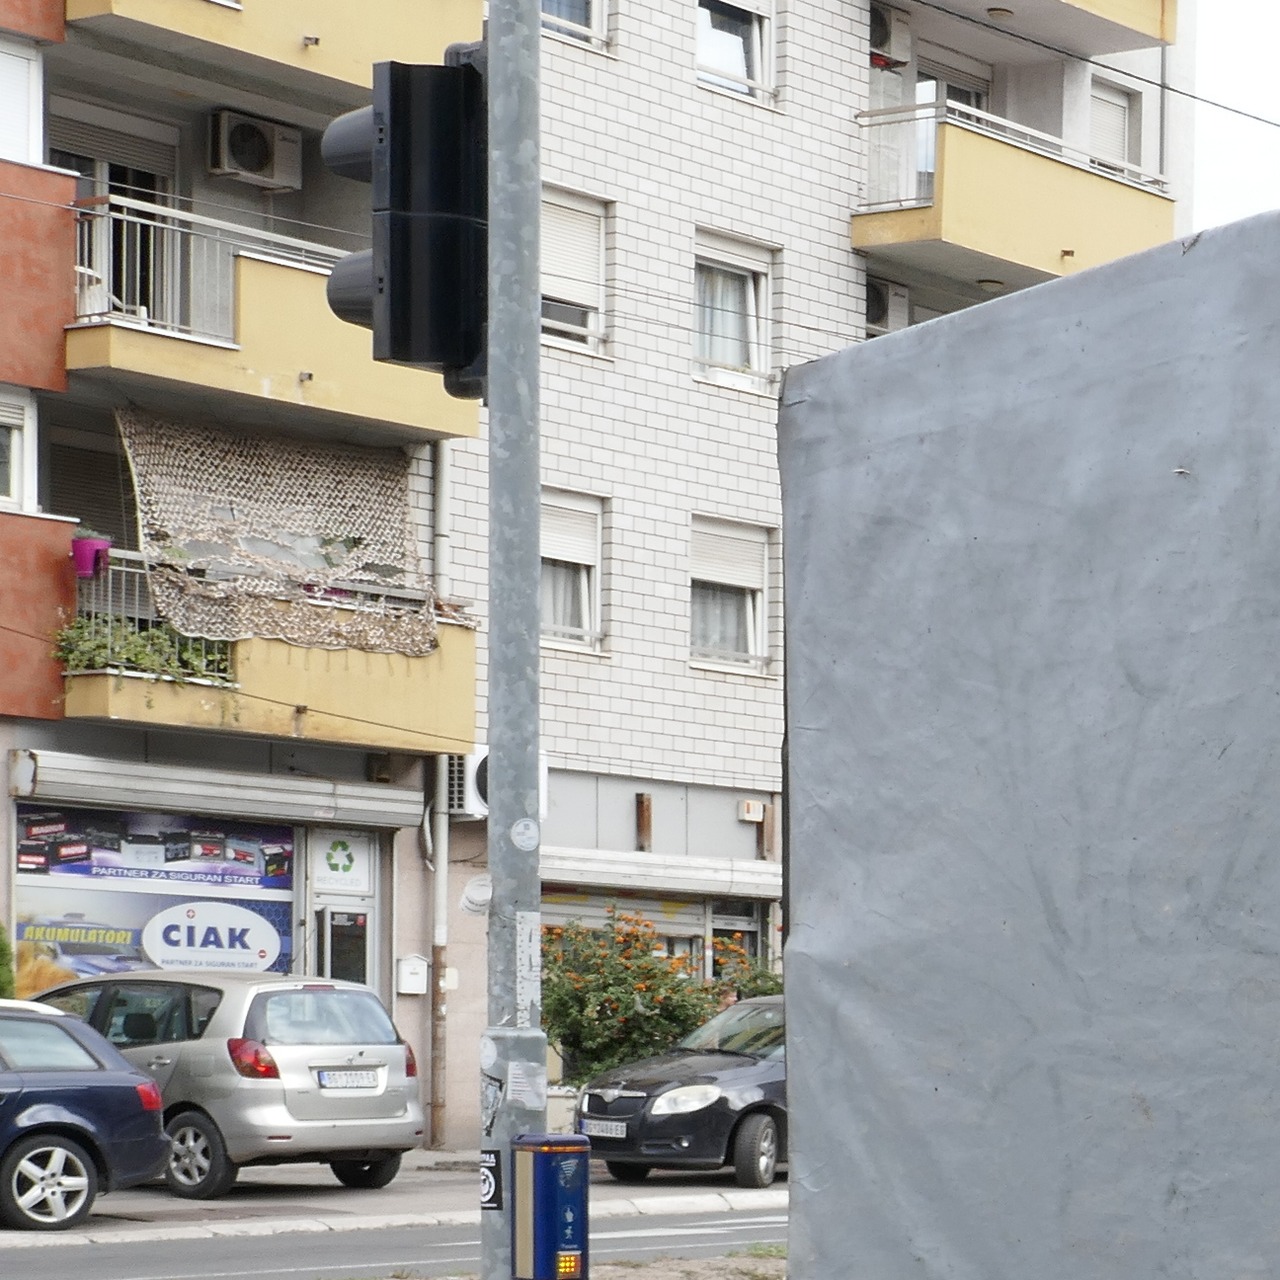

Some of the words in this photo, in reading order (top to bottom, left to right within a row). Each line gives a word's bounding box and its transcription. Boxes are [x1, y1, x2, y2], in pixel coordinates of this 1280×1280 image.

[92, 866, 149, 878] PARTNER
[150, 869, 167, 879] ZA
[169, 872, 222, 883] SIGURAN
[223, 875, 261, 885] START
[24, 926, 133, 944] AKUMULATORI
